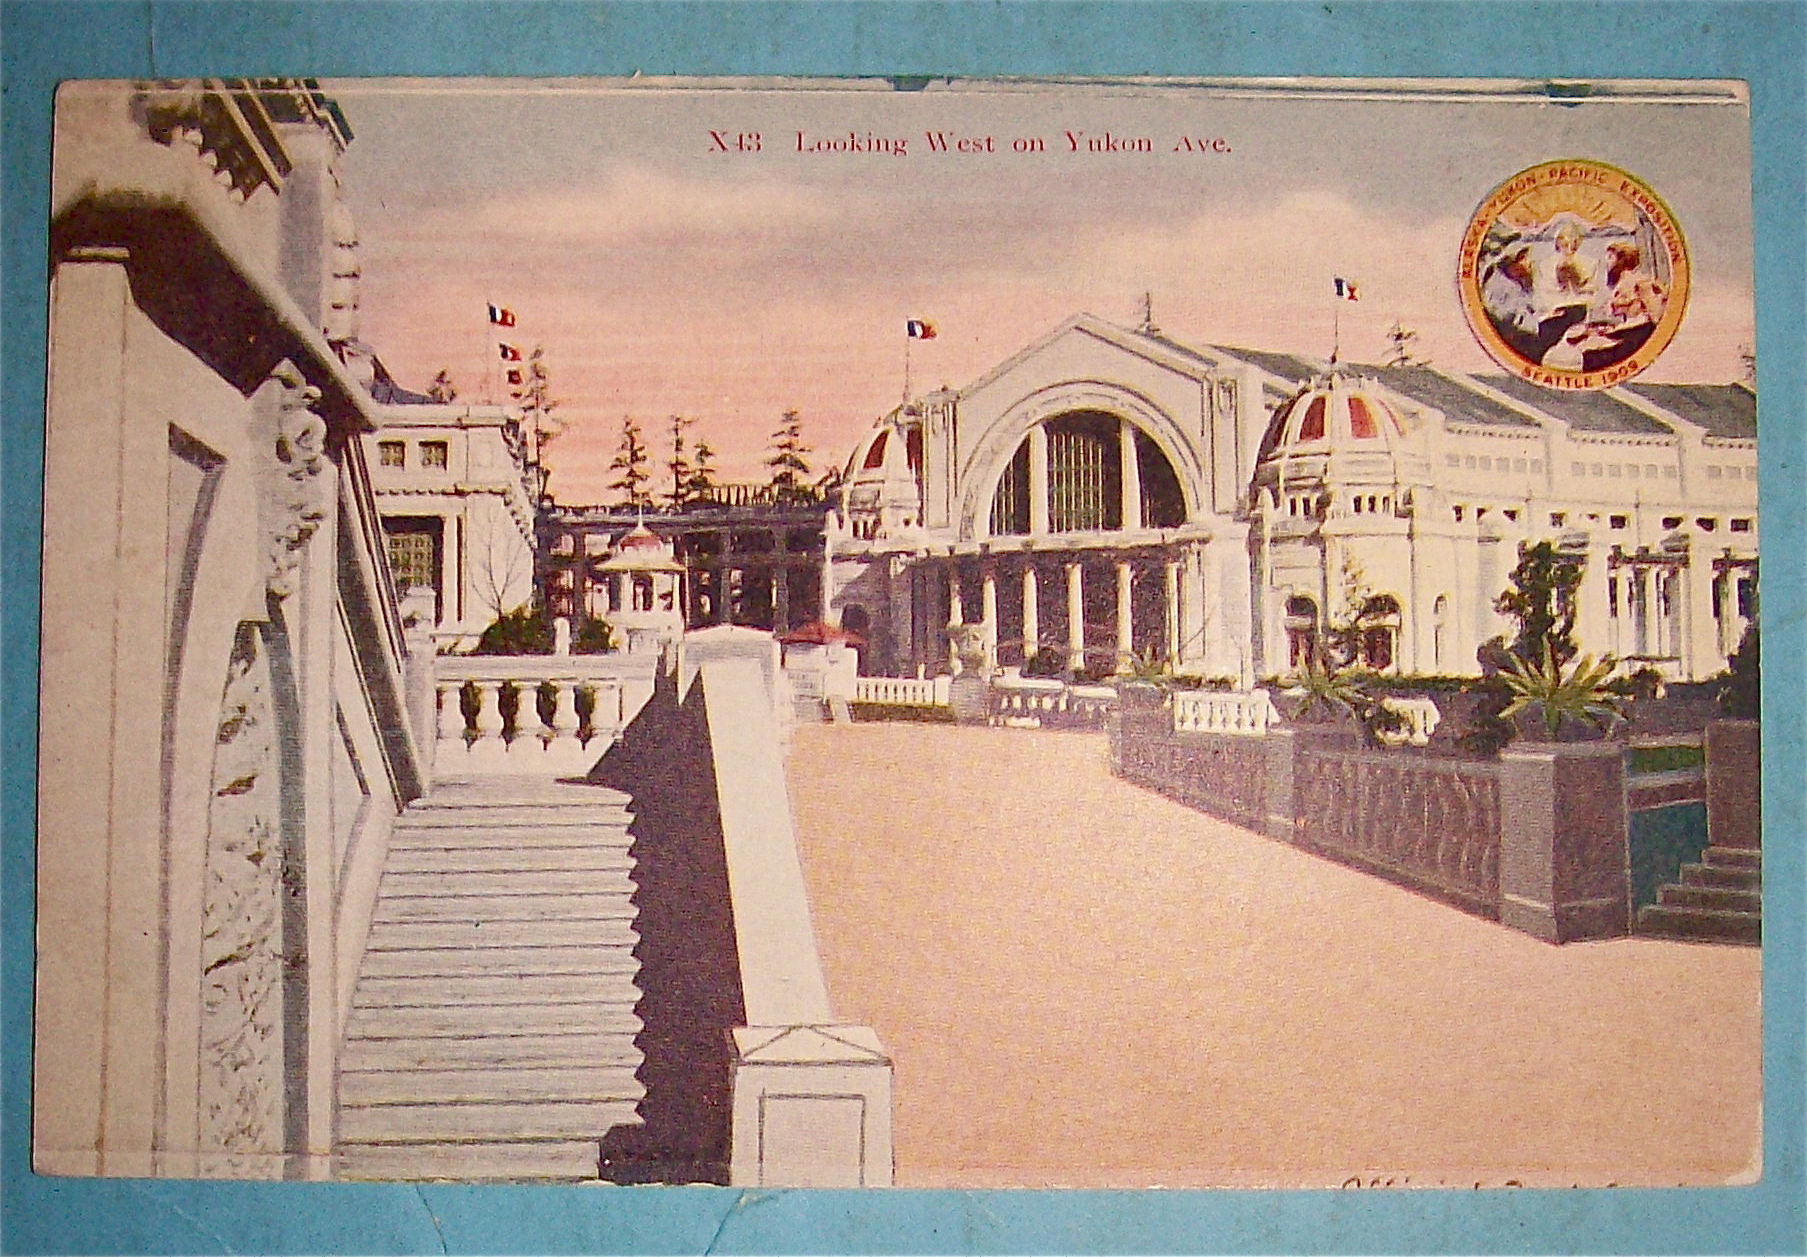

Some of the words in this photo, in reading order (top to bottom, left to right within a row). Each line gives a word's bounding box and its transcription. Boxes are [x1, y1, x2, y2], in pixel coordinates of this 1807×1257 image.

[795, 130, 909, 156] Looking
[925, 131, 995, 152] West
[1012, 137, 1045, 152] on
[1064, 130, 1152, 152] Yukon
[1173, 135, 1232, 153] Ave.
[1524, 366, 1593, 388] SEATTLE
[1602, 360, 1640, 385] 1909
